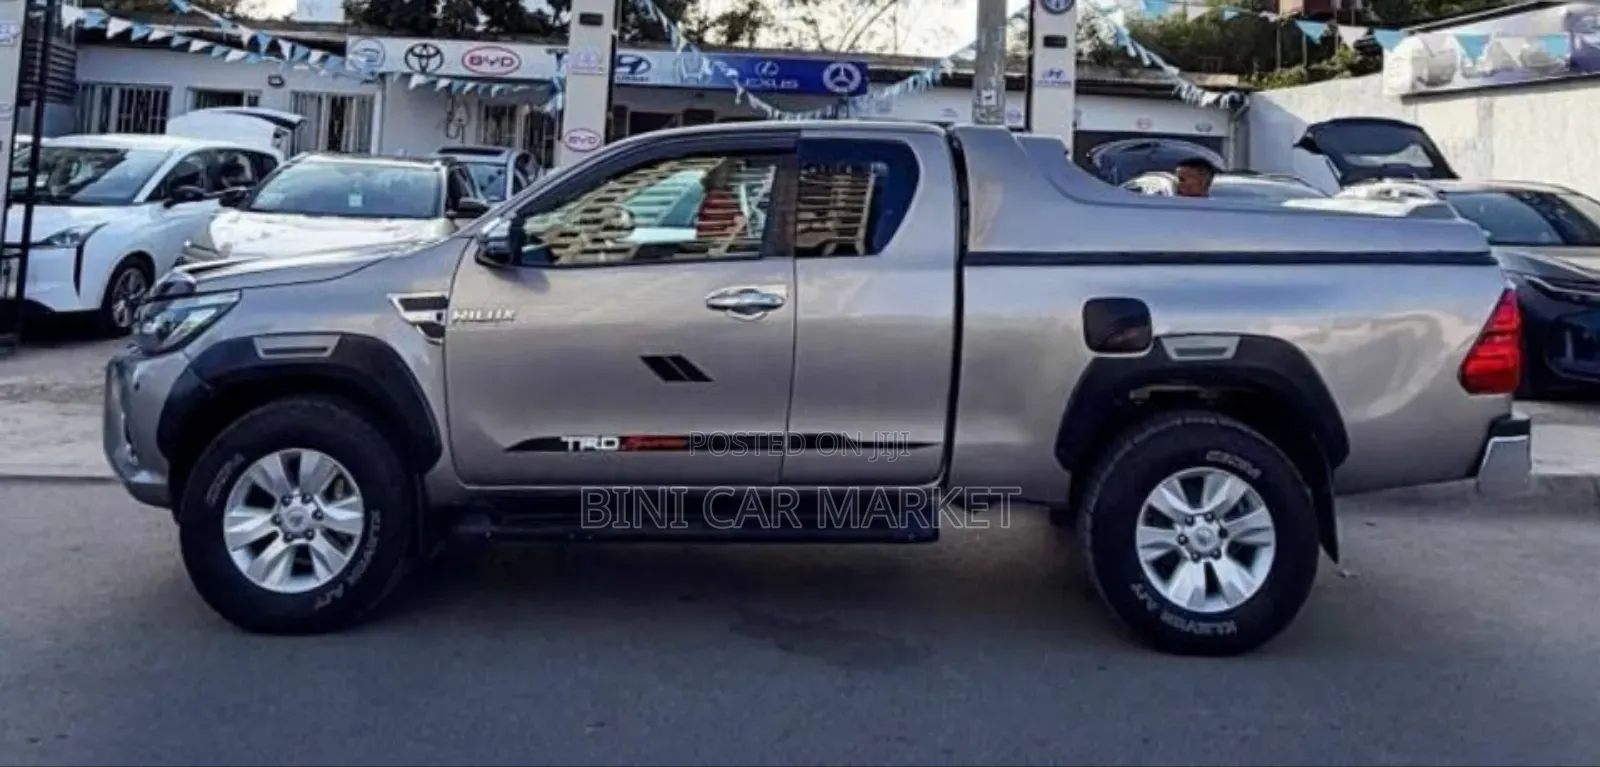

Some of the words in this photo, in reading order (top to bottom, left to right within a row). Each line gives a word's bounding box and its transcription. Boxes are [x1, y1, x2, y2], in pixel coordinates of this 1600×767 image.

[469, 55, 515, 68] BYD
[568, 136, 597, 144] BYD
[452, 308, 517, 322] HILUX
[561, 435, 620, 451] TRD
